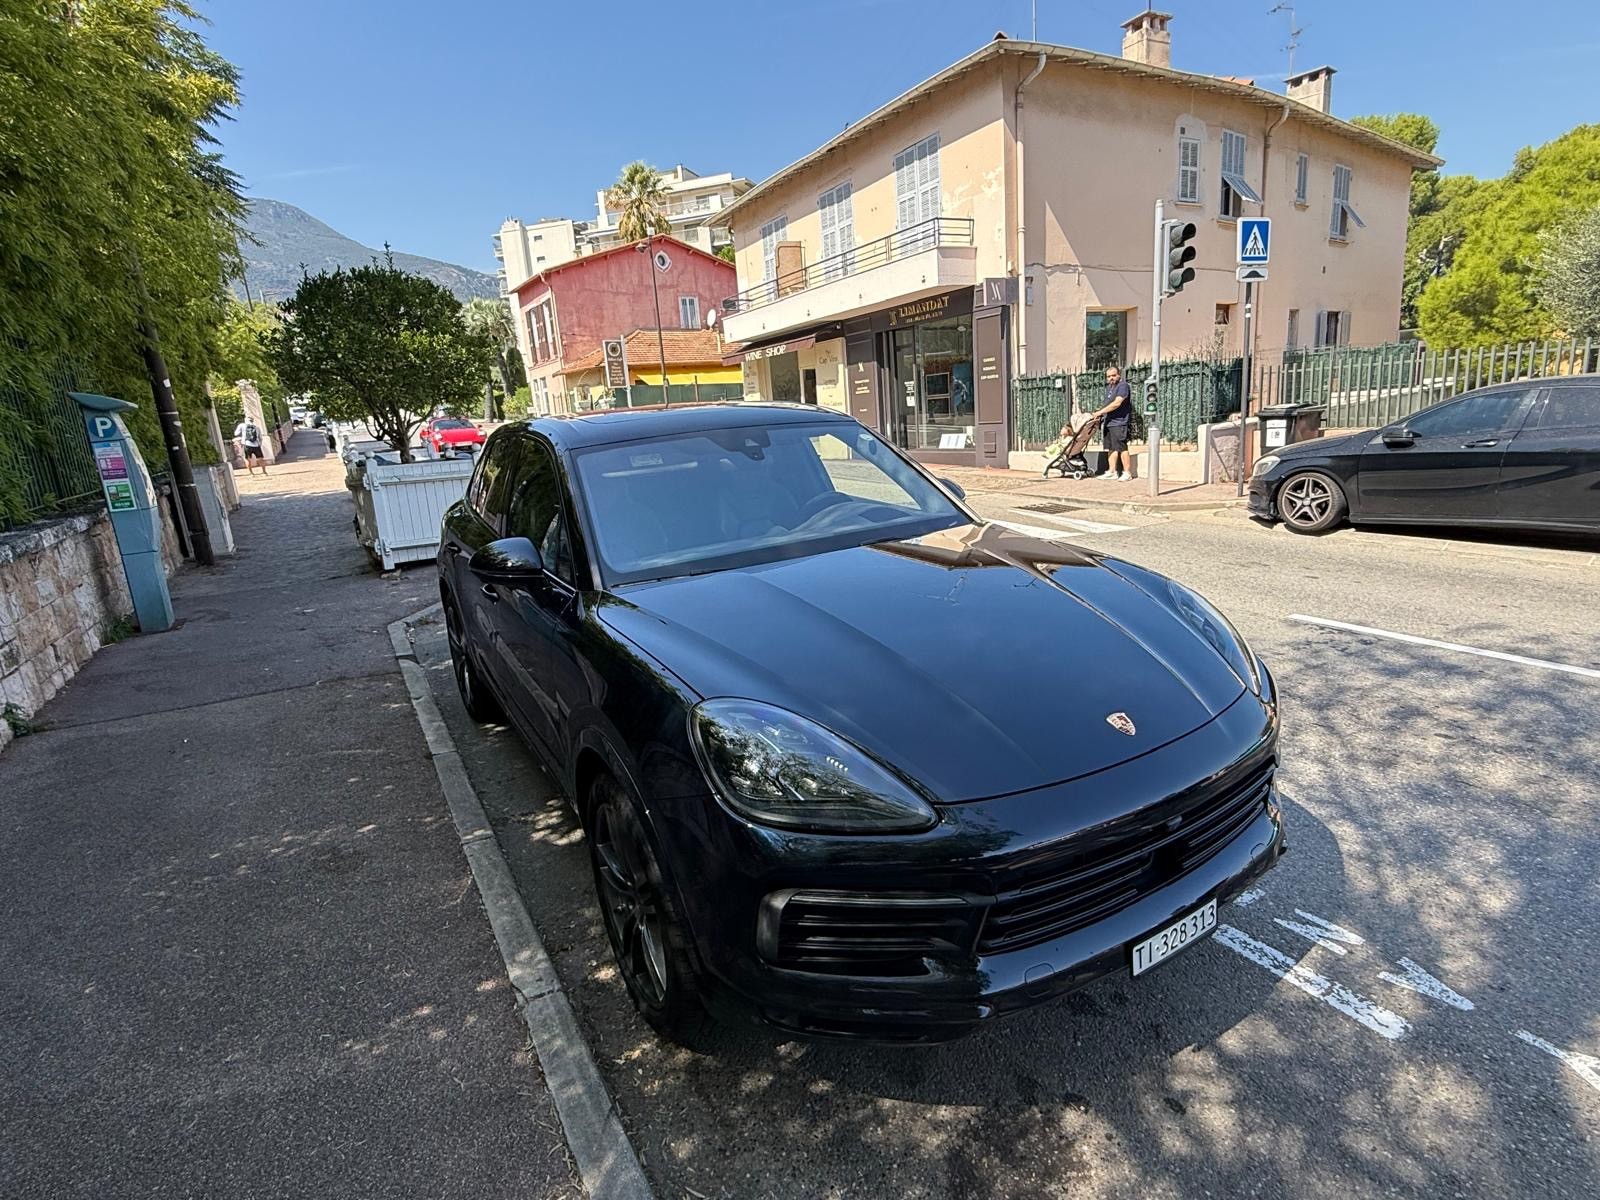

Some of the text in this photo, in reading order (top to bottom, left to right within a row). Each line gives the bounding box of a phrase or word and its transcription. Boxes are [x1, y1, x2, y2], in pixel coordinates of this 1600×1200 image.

[744, 344, 787, 361] WINE SHOP
[94, 416, 112, 438] P
